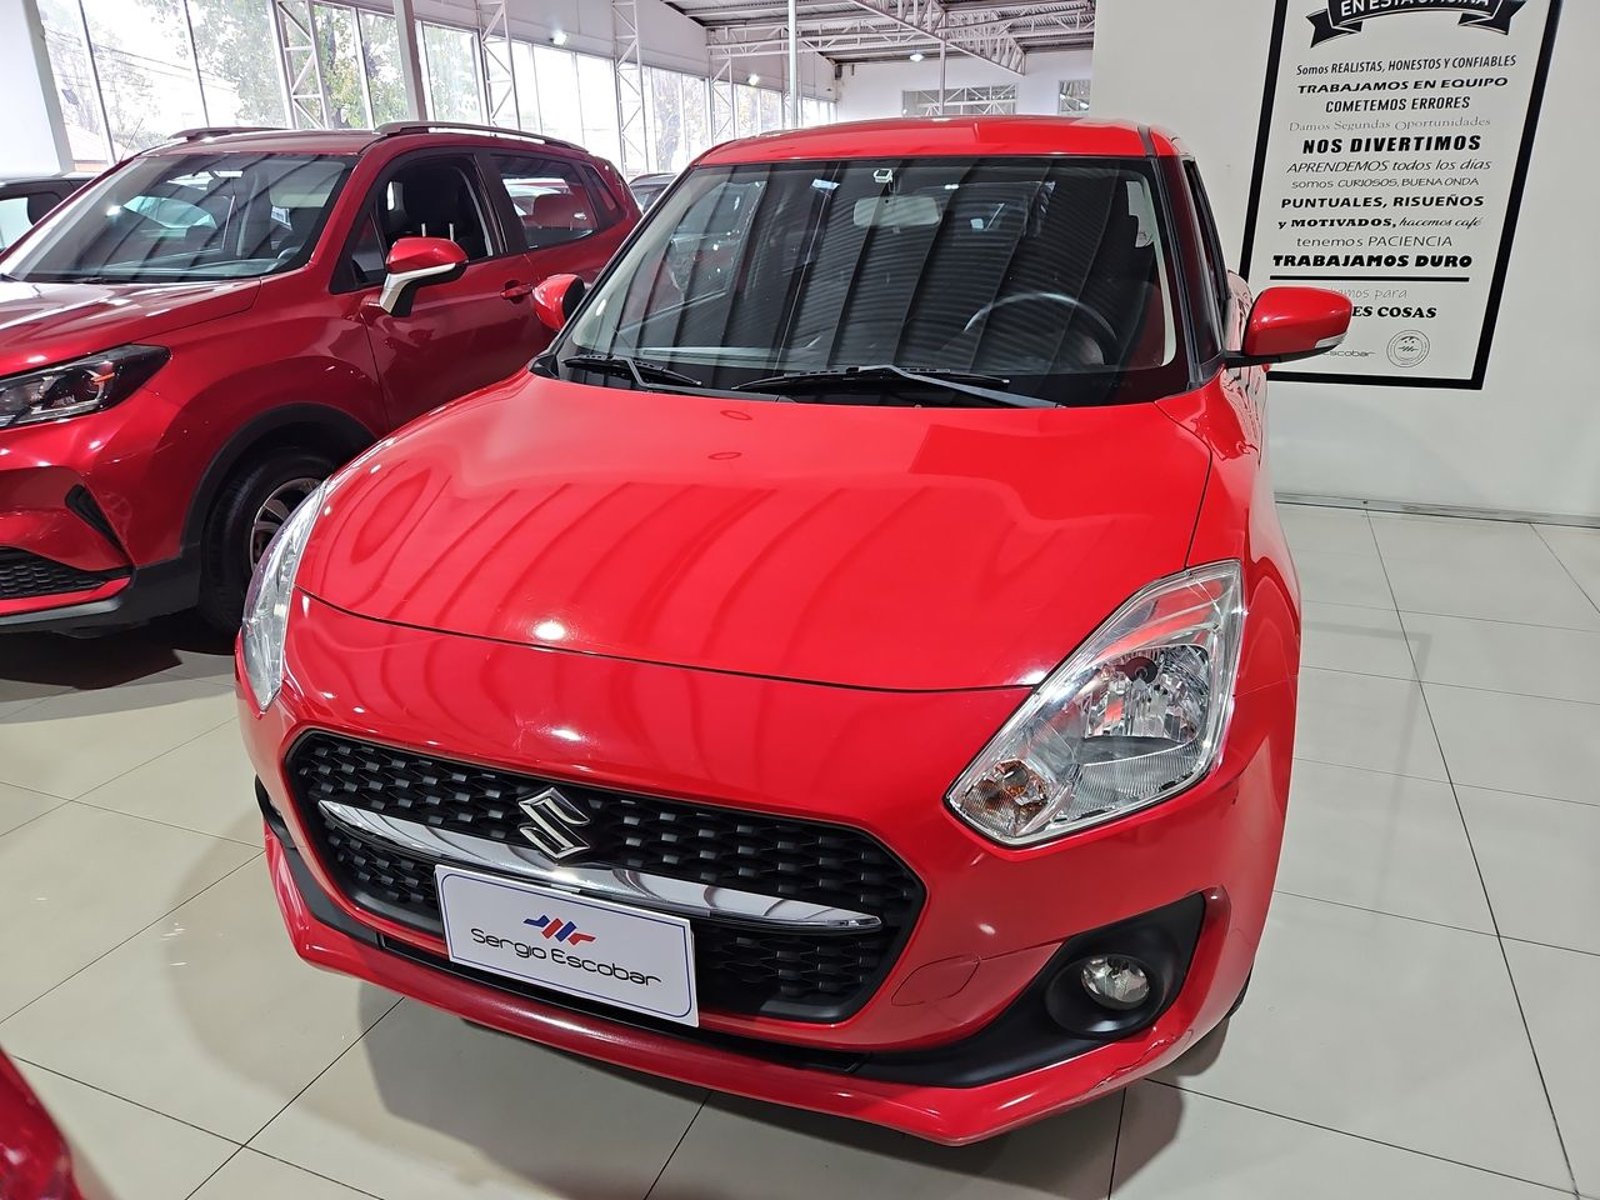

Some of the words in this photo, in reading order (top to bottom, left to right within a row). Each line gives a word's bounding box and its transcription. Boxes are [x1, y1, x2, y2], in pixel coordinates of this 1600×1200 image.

[1341, 0, 1365, 17] EN
[1296, 64, 1329, 75] Somos
[1331, 60, 1386, 73] REALISTAS,
[1388, 59, 1441, 71] HONESTOS
[1443, 58, 1451, 69] Y
[1452, 55, 1517, 68] CONFIABLES
[1297, 80, 1409, 94] TRABAJAMOS
[1413, 79, 1437, 90] EN
[1440, 77, 1509, 88] EQUIPO
[1325, 98, 1408, 113] COMETEMOS
[1411, 95, 1471, 110] ERRORES
[1289, 121, 1330, 132] Damos
[1333, 119, 1391, 131] Segundas
[1394, 115, 1491, 130] Oportunidades
[1302, 138, 1343, 154] NOS
[1349, 135, 1482, 153] DIVERTIMOS
[1286, 160, 1390, 174] APRENDEMOS
[1392, 159, 1433, 171] todos
[1435, 159, 1457, 171] los
[1291, 180, 1335, 189] somos
[1337, 178, 1400, 188] CURIOSOS,
[1401, 178, 1444, 187] BUENA
[1444, 177, 1480, 186] ONDA
[1280, 196, 1388, 209] PUNTUALES,
[1393, 193, 1485, 207] RISUEÑOS
[1278, 221, 1287, 230] y
[1290, 218, 1397, 228] MOTIVADOS,
[1399, 216, 1453, 227] hacemos
[1454, 216, 1485, 230] café
[1296, 238, 1364, 247] tenemos
[1368, 235, 1453, 247] PACIENCIA
[1273, 254, 1410, 267] TRABAJAMOS
[1414, 255, 1473, 268] DURO
[1374, 288, 1408, 300] para
[1377, 306, 1438, 319] COSAS
[470, 927, 548, 958] Sergio
[550, 948, 662, 987] Escobar
